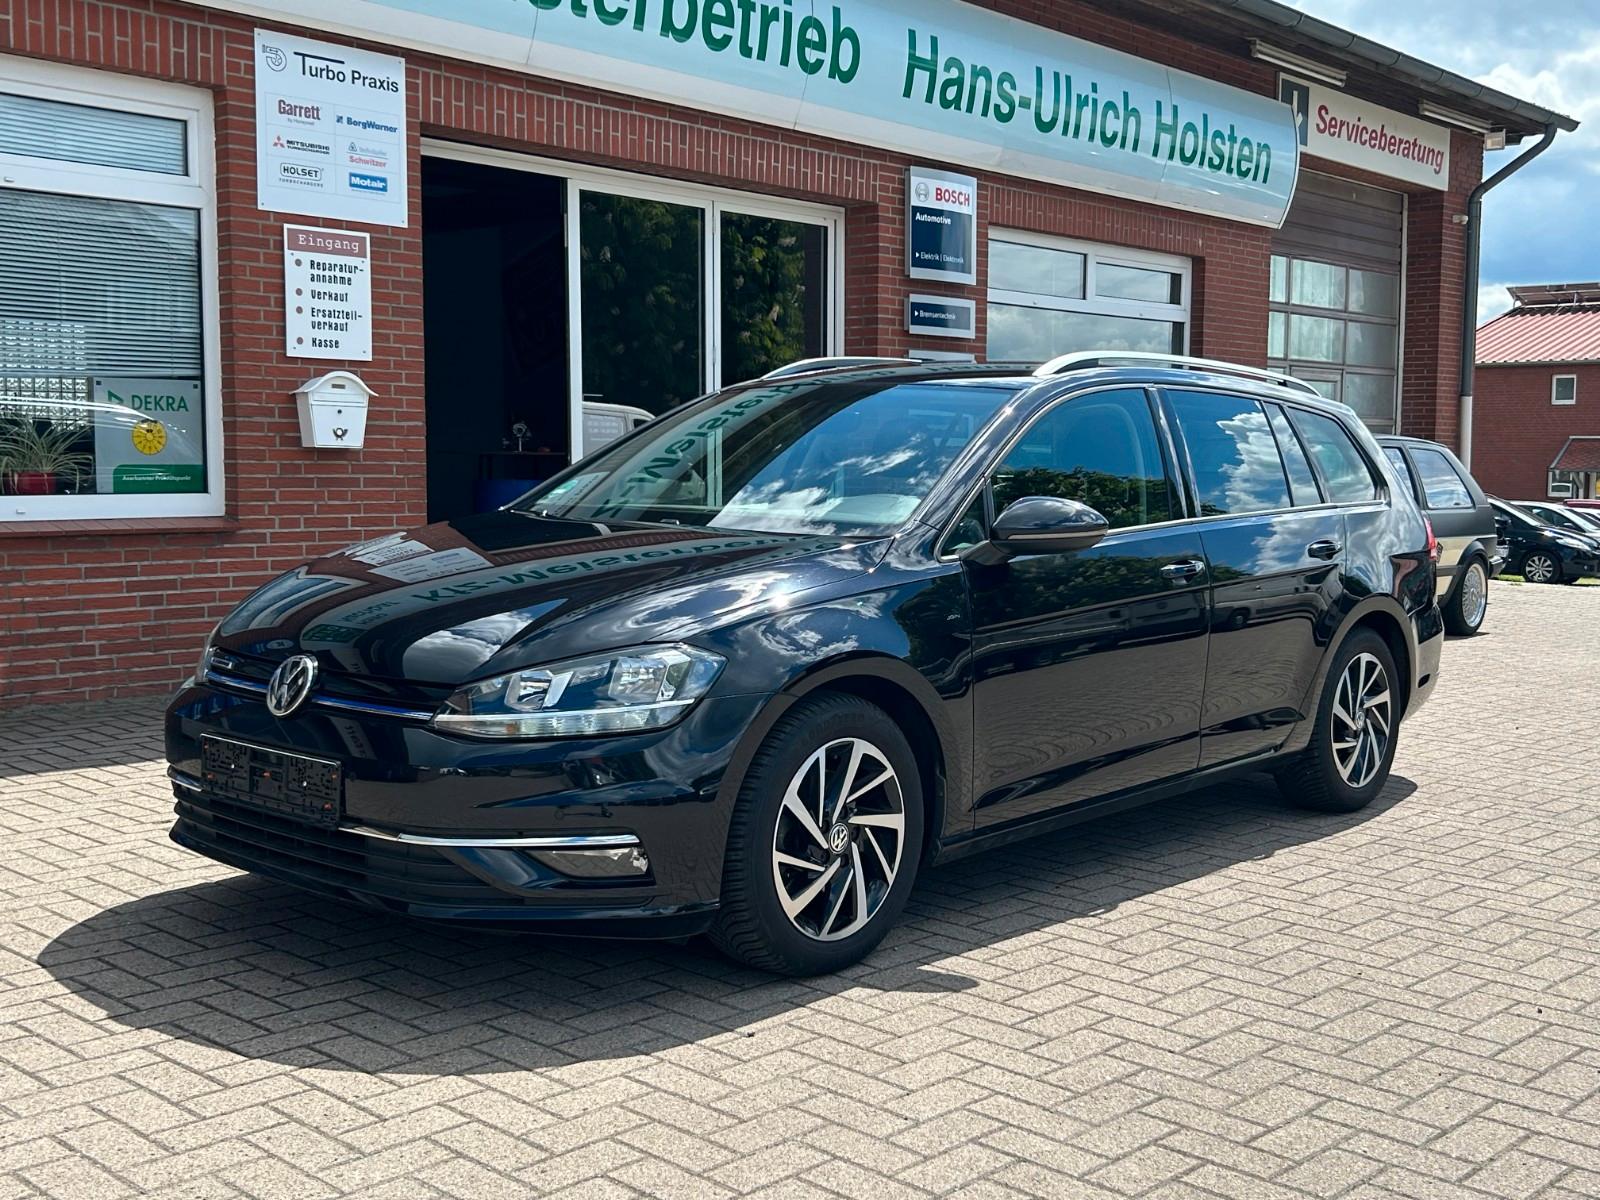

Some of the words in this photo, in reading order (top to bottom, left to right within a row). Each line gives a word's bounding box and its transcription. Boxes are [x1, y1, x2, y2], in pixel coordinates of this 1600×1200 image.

[293, 52, 345, 83] Turbo
[351, 70, 399, 93] Praxis
[278, 99, 321, 121] Garrett
[902, 29, 1142, 152] Hans-Ulrich
[1152, 100, 1272, 184] Holsten
[346, 117, 398, 133] BorgWarner
[1315, 104, 1445, 175] Serviceberatung
[349, 155, 387, 168] Schwitzer
[283, 166, 319, 178] HOLSET
[351, 176, 386, 188] Motair
[935, 187, 970, 207] BOSCH
[915, 212, 952, 226] Automotive
[298, 234, 359, 253] Eingang
[920, 251, 939, 262] Elektrik
[310, 259, 364, 275] Reparatur-
[310, 273, 352, 286] annahme
[311, 289, 348, 302] Verkauf
[311, 307, 363, 321] Ersatzteil-
[311, 320, 348, 332] verkauf
[312, 337, 340, 349] Kasse
[131, 395, 189, 412] DEKRA
